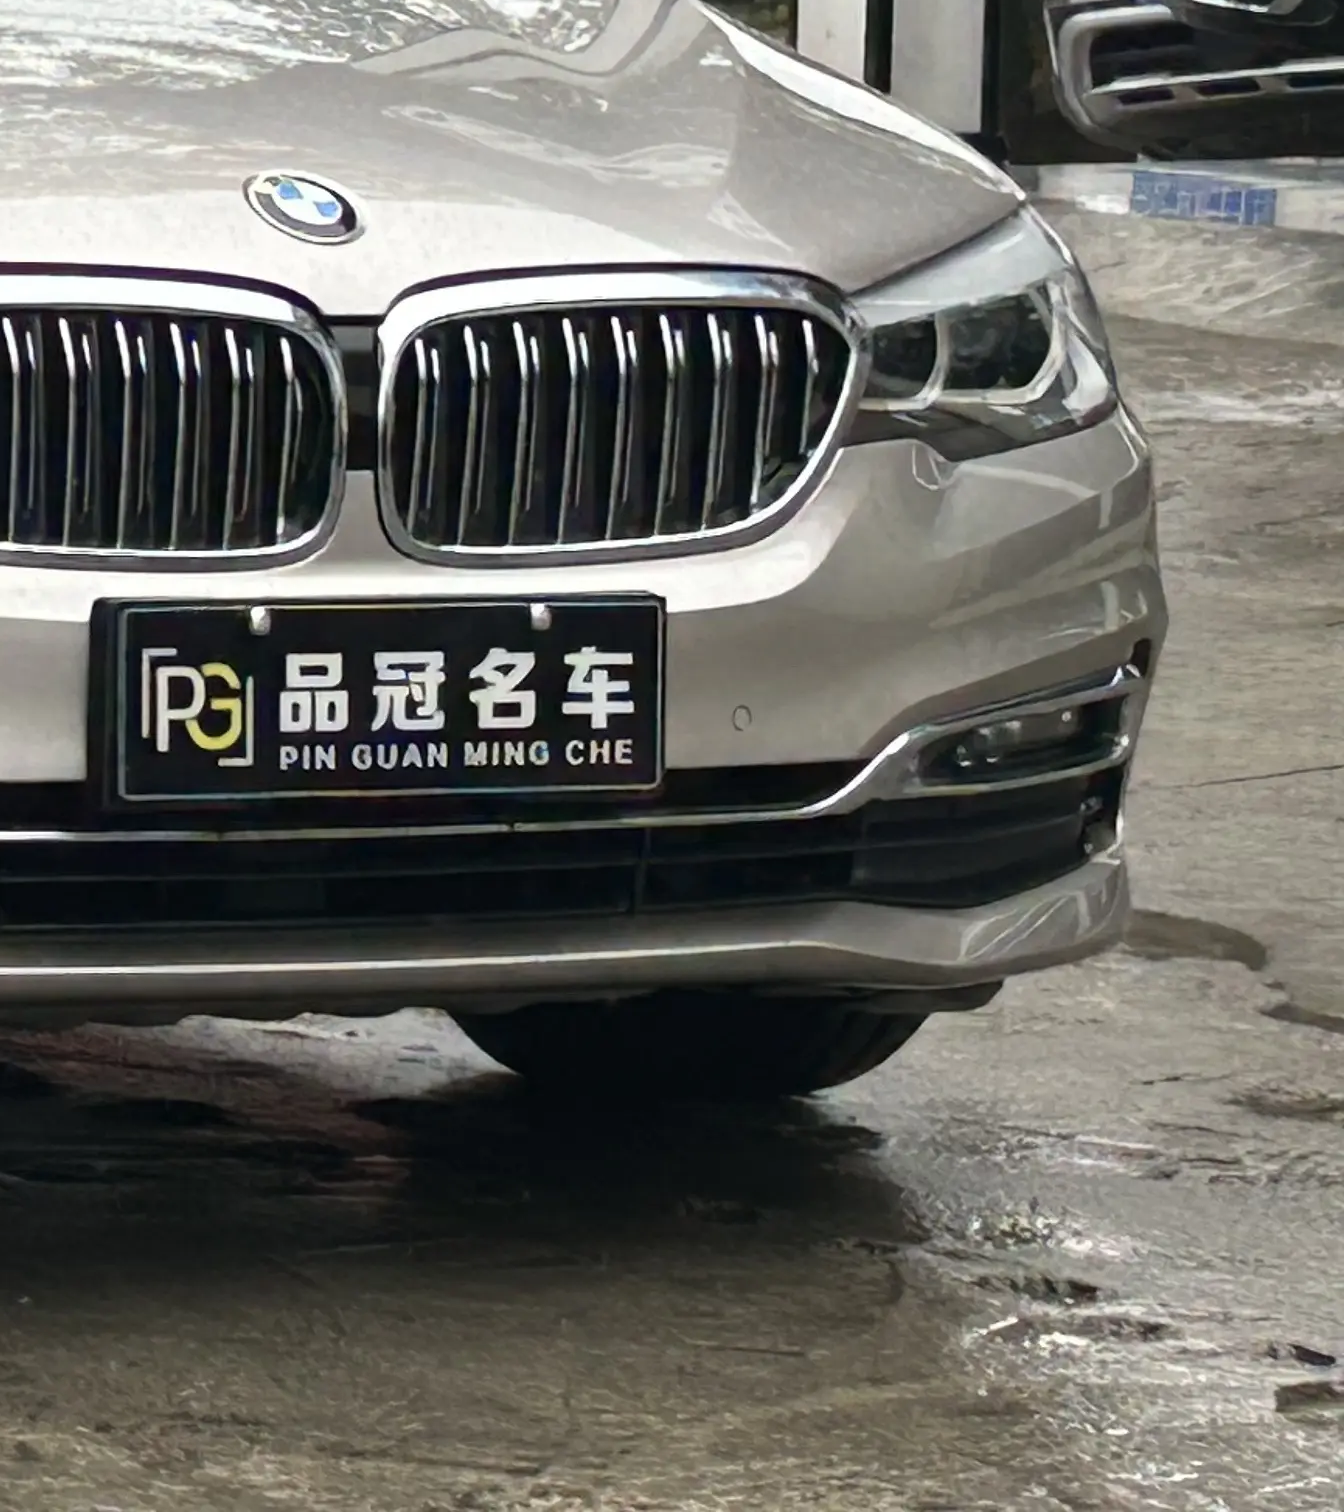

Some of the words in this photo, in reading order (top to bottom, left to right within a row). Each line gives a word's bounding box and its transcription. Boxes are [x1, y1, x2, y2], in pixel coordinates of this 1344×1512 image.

[278, 646, 635, 733] 品冠名车
[278, 742, 337, 771] PIN
[351, 741, 449, 769] GUAN
[463, 739, 551, 767] MING
[564, 738, 635, 766] CHE
